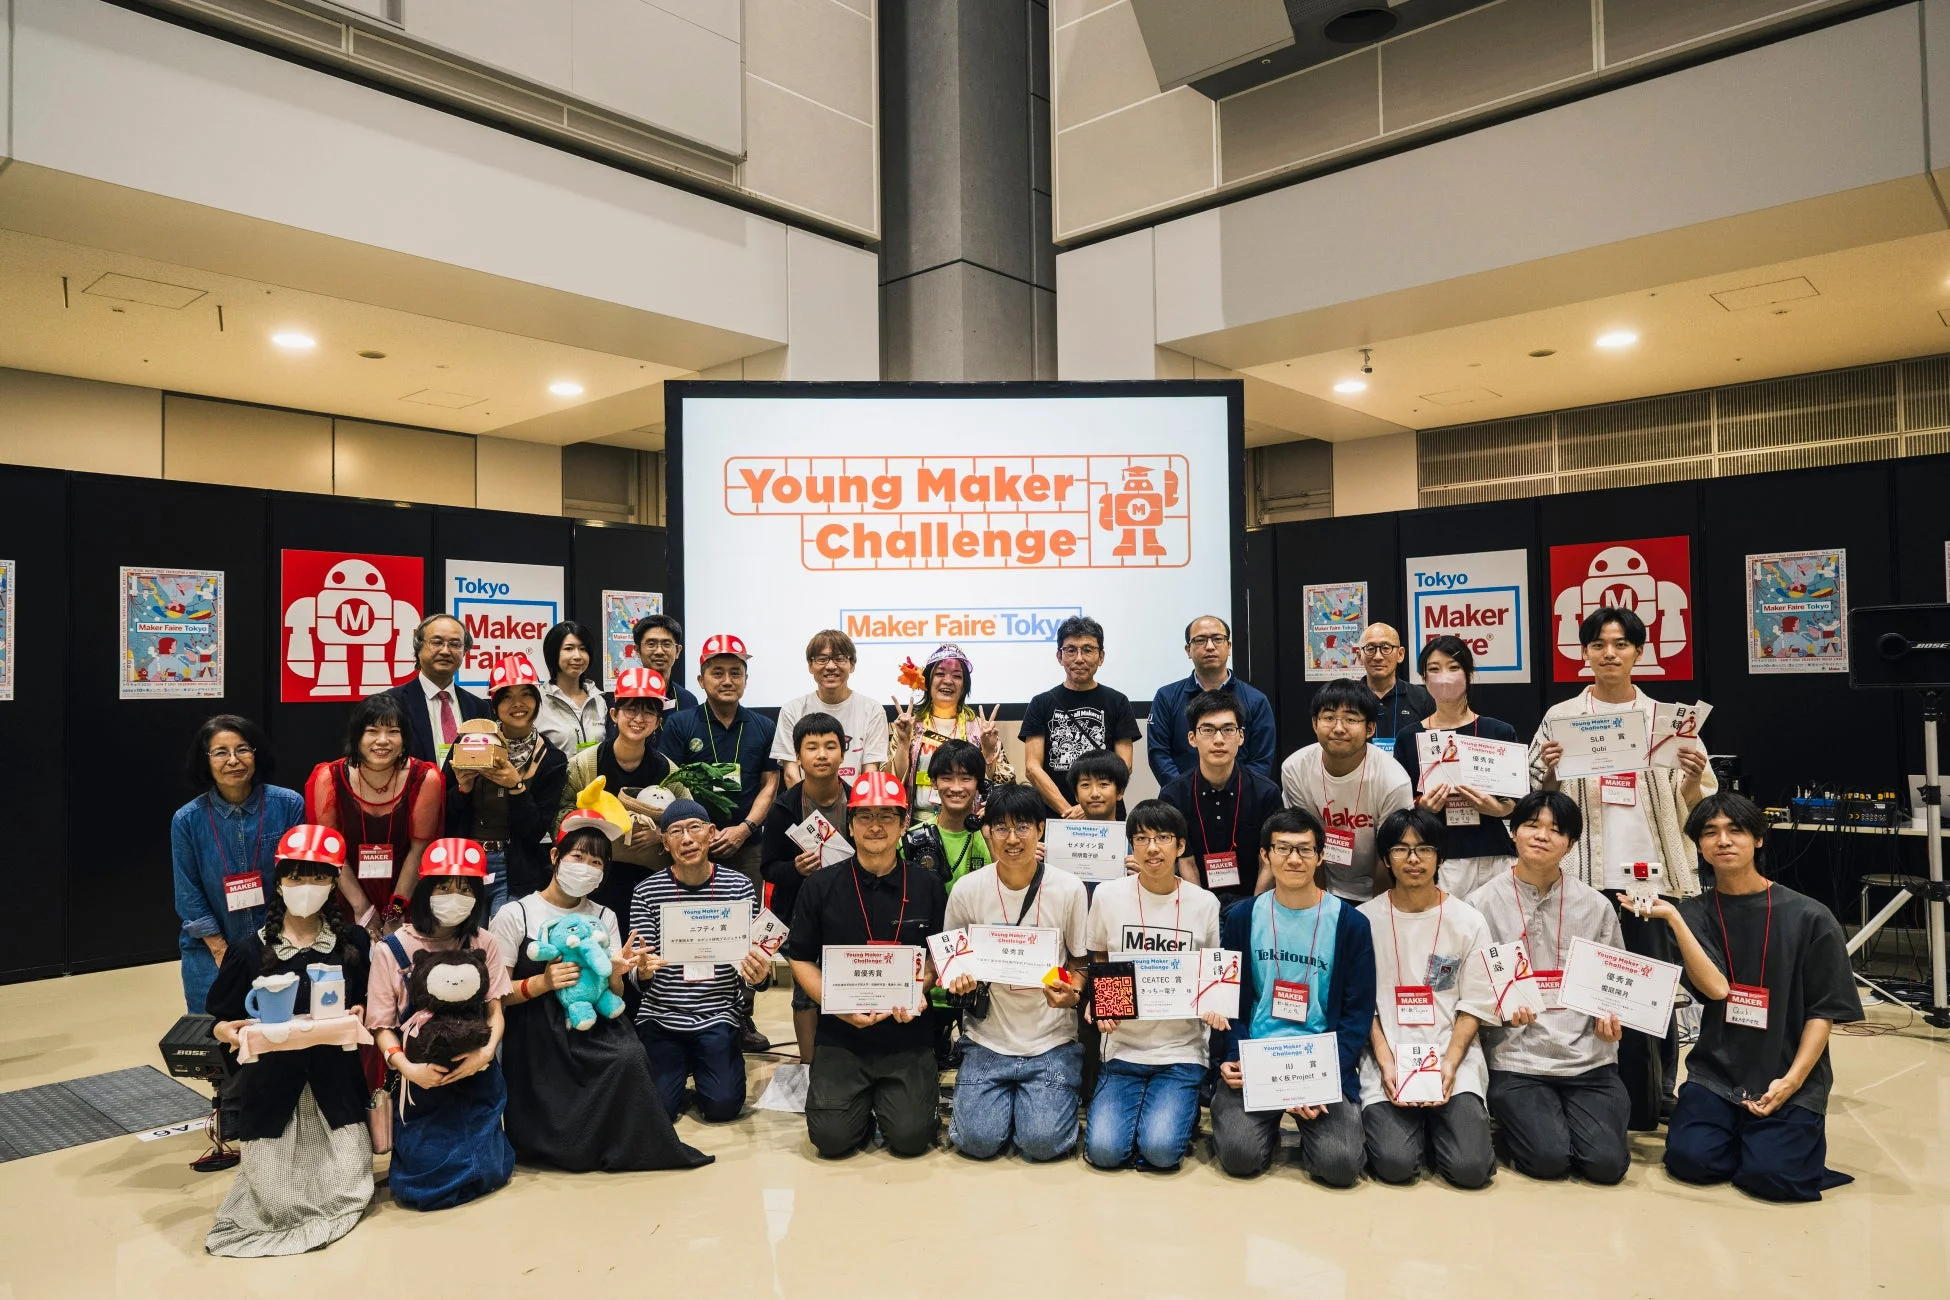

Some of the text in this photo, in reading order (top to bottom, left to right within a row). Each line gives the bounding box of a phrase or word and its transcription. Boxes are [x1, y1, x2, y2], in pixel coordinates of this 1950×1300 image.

[739, 466, 1073, 511] Young Maker
[816, 521, 1077, 564] Challenge
[1415, 572, 1468, 590] Tokyo
[455, 576, 510, 598] Tokyo
[1807, 602, 1830, 611] Tokyo
[342, 603, 369, 631] M
[1425, 604, 1509, 629] Maker
[185, 625, 207, 633] Tokyo
[465, 614, 548, 640] Maker
[847, 613, 1067, 640] Maker Faire Toky
[1580, 724, 1611, 732] Challenge
[1590, 732, 1625, 743] SLB 賞
[1430, 732, 1441, 755] 目録
[1591, 745, 1607, 753] Qubi
[1473, 755, 1495, 765] 優秀賞
[1605, 779, 1631, 788] MAKER
[1327, 837, 1350, 847] MAKER
[1209, 861, 1233, 869] MAKER
[229, 881, 258, 893] MAKER
[720, 924, 727, 932] 賞
[941, 934, 956, 954] 目録
[1126, 931, 1187, 952] Maker
[1002, 947, 1025, 956] 優秀賞
[1213, 952, 1224, 976] 目録
[1255, 949, 1329, 971] Tekitounix
[1489, 947, 1505, 972] 目録
[1596, 951, 1639, 968] Young Maker
[1604, 960, 1639, 974] Challenge
[853, 969, 883, 978] 最優秀賞
[1141, 976, 1182, 984] CEATEC 賞
[1606, 972, 1634, 987] 優秀賞
[1277, 991, 1304, 1001] MAKER
[1400, 997, 1428, 1005] MAKER
[1732, 995, 1763, 1006] MAKER
[1309, 1060, 1317, 1068] 賞
[1271, 1075, 1291, 1083] 動く板
[1291, 1073, 1315, 1081] Project
